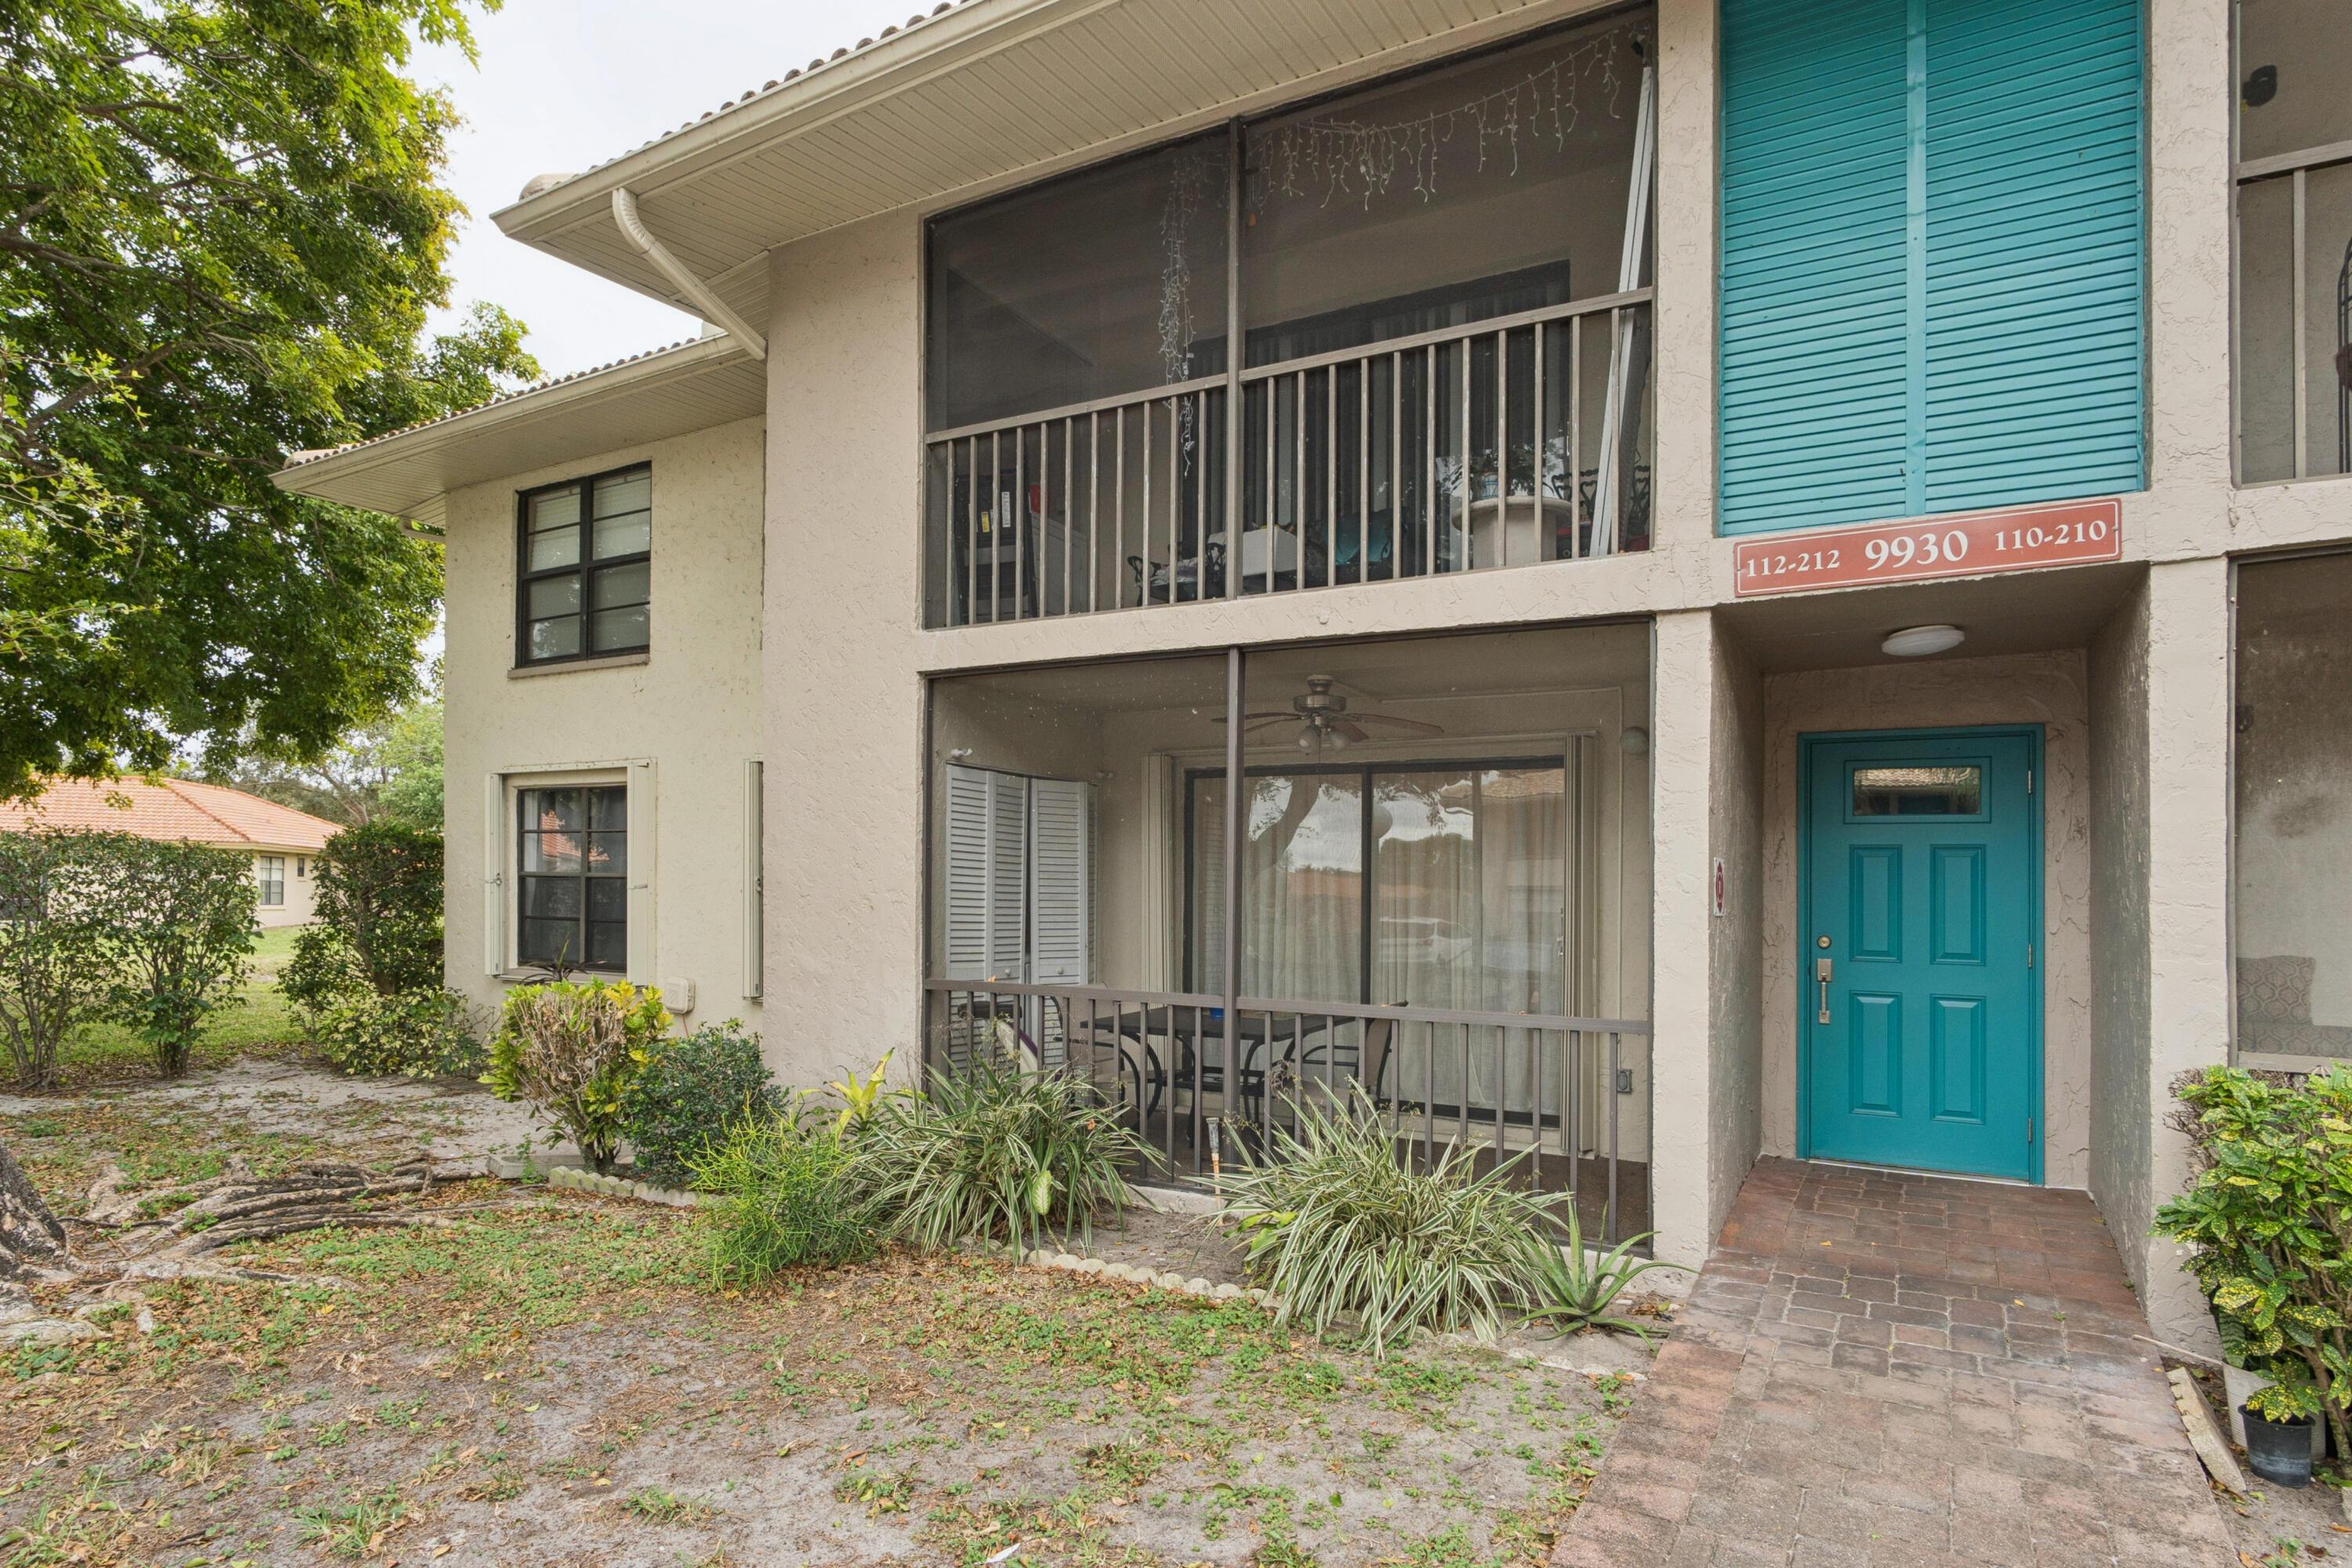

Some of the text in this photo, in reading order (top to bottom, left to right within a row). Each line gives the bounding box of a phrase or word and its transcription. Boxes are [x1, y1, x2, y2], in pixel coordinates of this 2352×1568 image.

[1747, 520, 2107, 577] 112-212 9930 110-210
